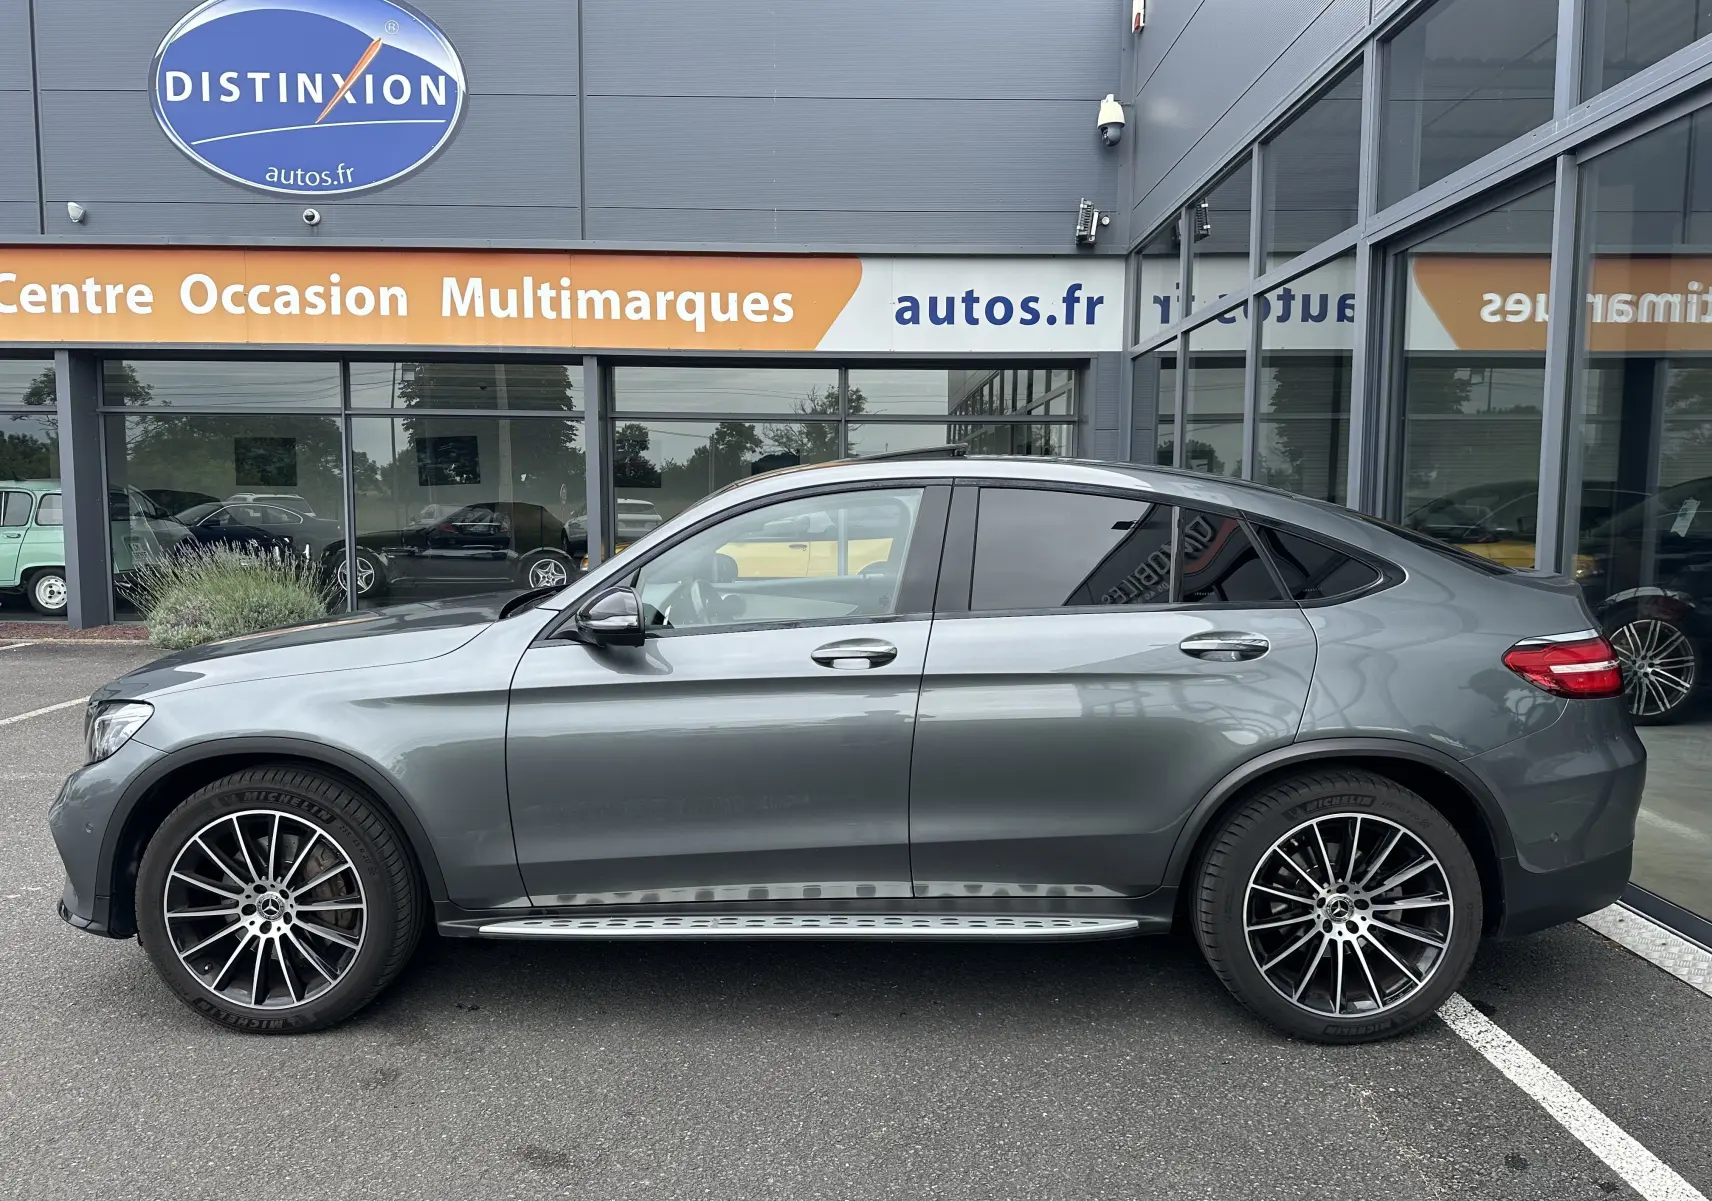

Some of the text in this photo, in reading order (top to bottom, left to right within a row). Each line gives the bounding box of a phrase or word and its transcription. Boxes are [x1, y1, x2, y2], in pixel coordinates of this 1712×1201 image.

[165, 69, 447, 106] DISTINXION
[265, 163, 356, 188] autos.fr
[180, 273, 408, 318] Occasion
[442, 276, 794, 333] Multimarques
[894, 283, 1105, 327] autos.fr
[244, 790, 335, 822] MICHELIN
[196, 998, 285, 1030] MICHELIN
